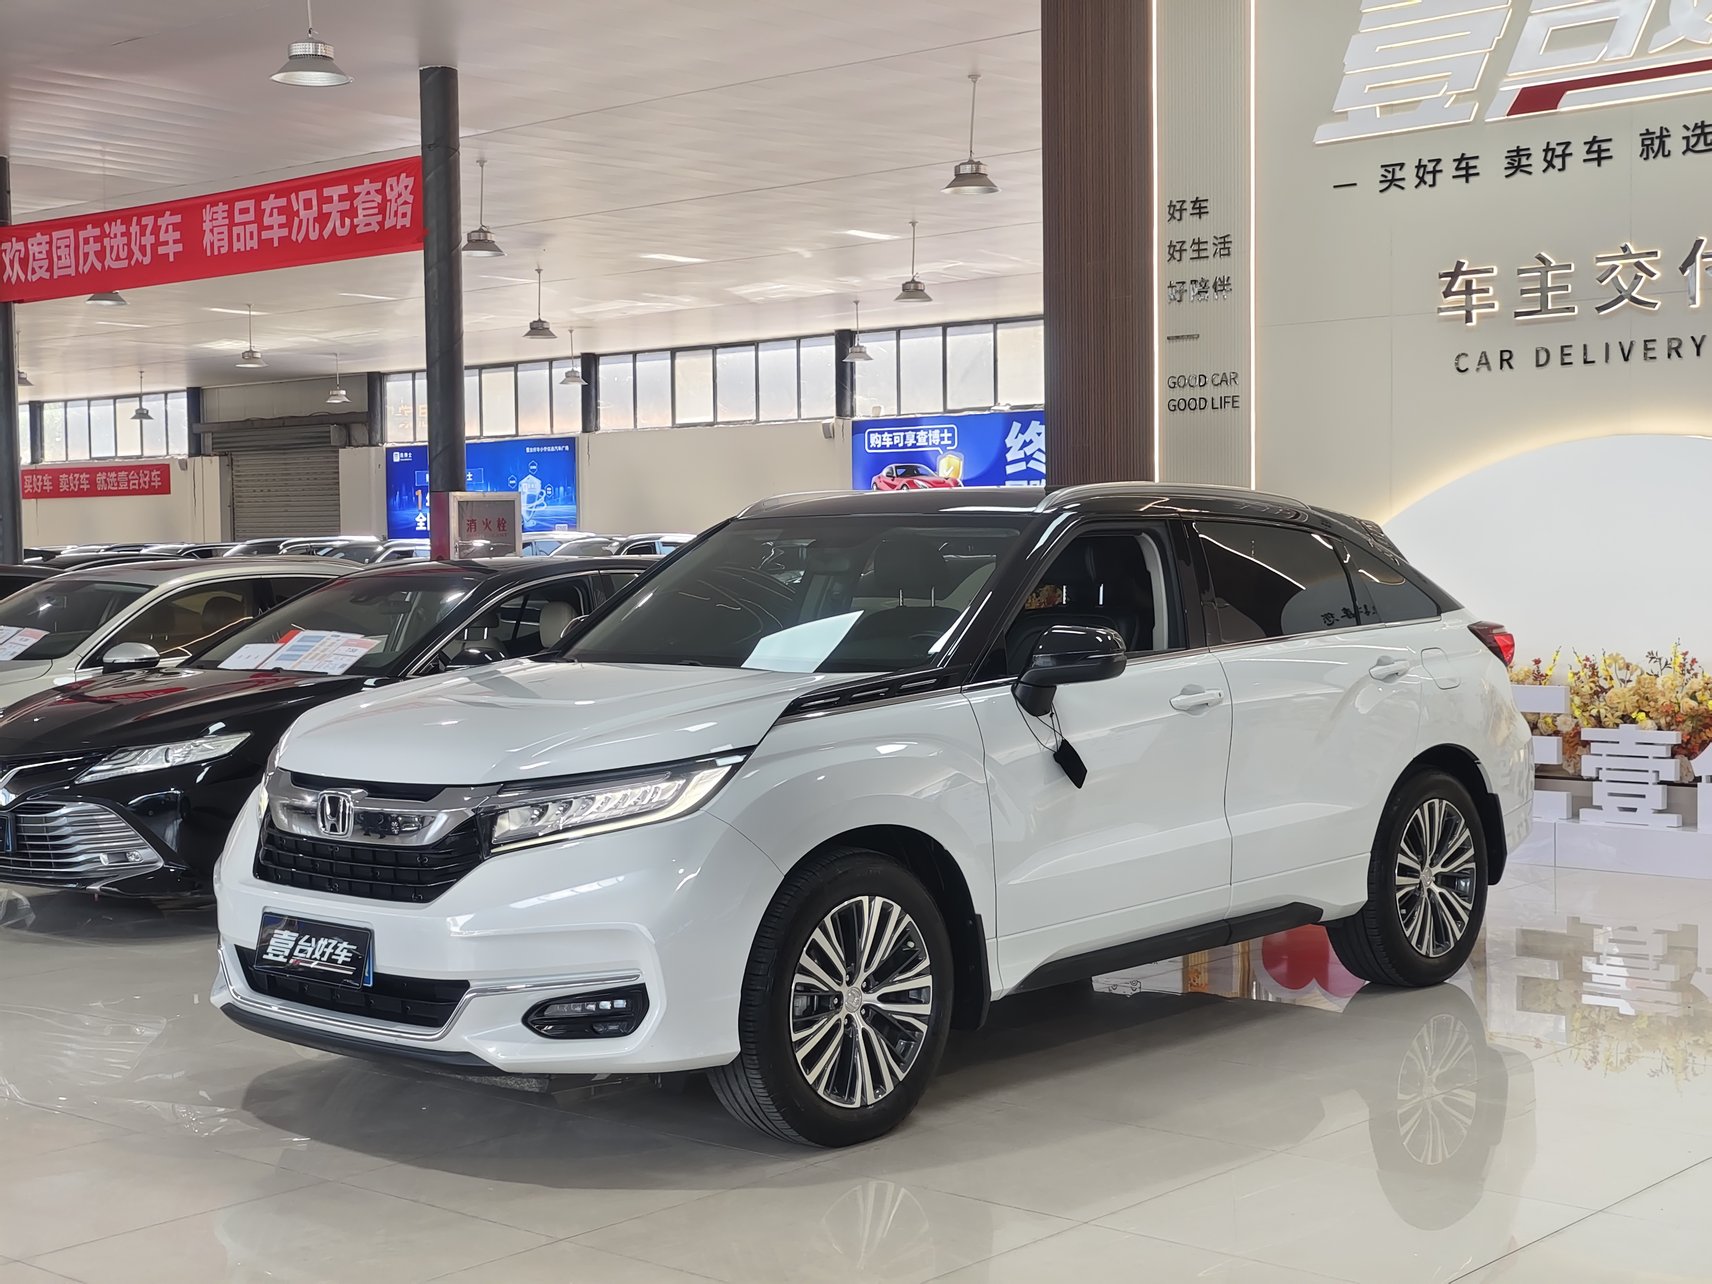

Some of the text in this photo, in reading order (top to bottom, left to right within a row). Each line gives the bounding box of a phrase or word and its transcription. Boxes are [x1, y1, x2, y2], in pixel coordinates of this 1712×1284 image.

[1379, 120, 1712, 193] 买好车 卖好车 就选
[1167, 197, 1209, 222] 好车
[1, 173, 416, 285] 欢度国庆选好车 精品车况无套路
[1167, 234, 1232, 262] 好生活
[1167, 275, 1232, 303] 好陪伴
[1454, 334, 1706, 373] CAR DELIVERY
[1167, 371, 1239, 389] GOOD CAR
[1167, 395, 1240, 412] GOOD LIFE
[870, 429, 952, 448] 购车可享查博士
[24, 470, 162, 493] 买好车 卖好车 就选壹台好车
[466, 517, 507, 533] 消火栓
[262, 929, 357, 964] 壹台好车
